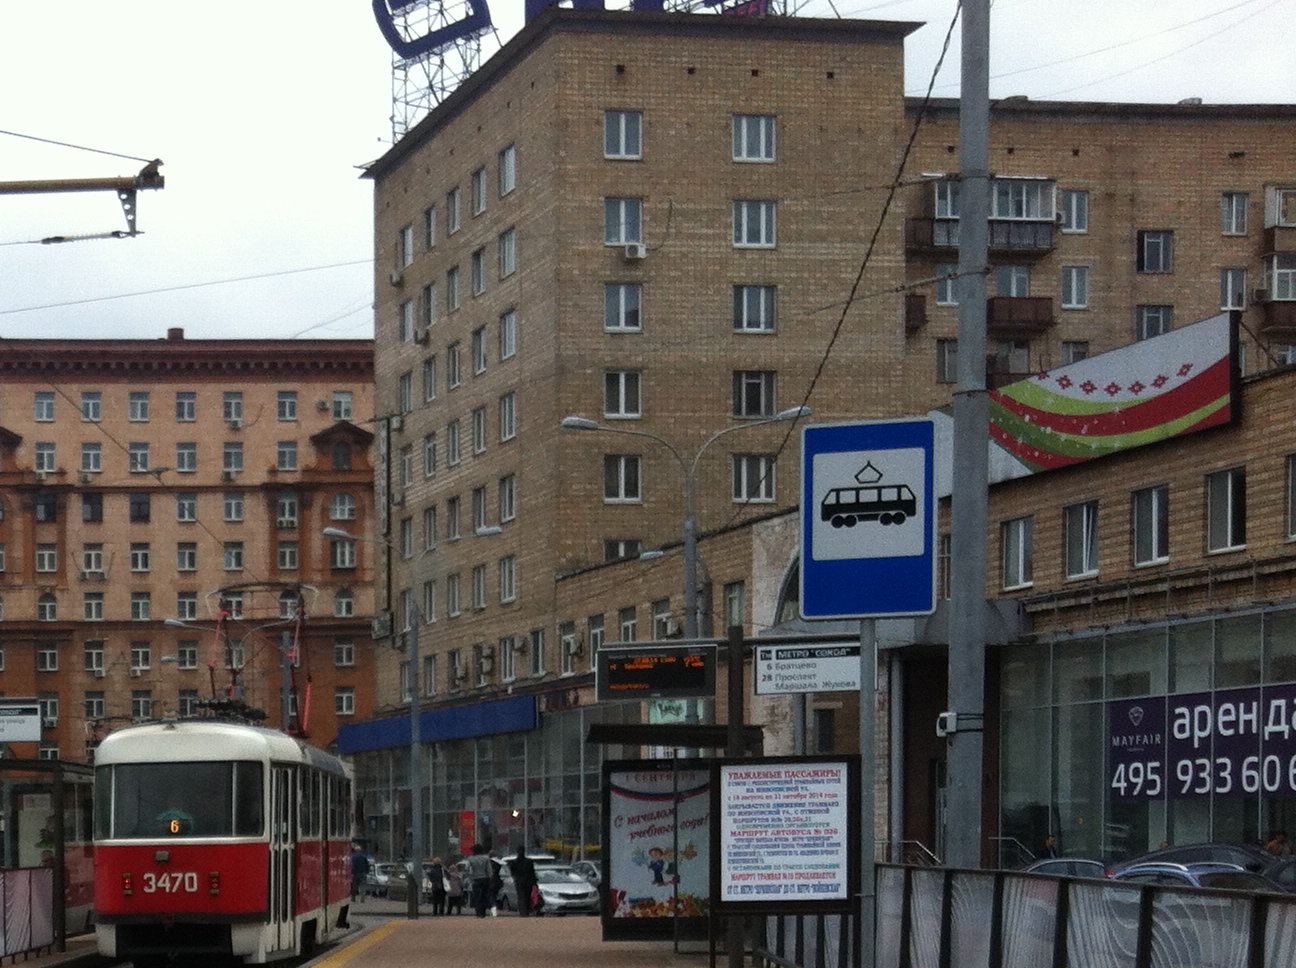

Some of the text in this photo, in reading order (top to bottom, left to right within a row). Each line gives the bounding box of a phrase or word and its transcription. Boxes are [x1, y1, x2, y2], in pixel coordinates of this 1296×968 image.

[778, 651, 809, 659] МЕТРО
[810, 648, 851, 657] "СОКОЛ"
[766, 662, 817, 672] 6 Братцево
[775, 673, 817, 682] Проспект
[775, 681, 856, 690] Маршала Жукова
[1173, 699, 1296, 749] аренд
[1112, 733, 1161, 747] MAYFAIR
[728, 769, 841, 780] УВАЖАЕМЫЕ ПАССАЖИРЫ!
[1111, 761, 1161, 796] 495
[1176, 757, 1232, 794] 933
[1241, 755, 1281, 793] 60
[170, 820, 179, 833] 6
[143, 872, 198, 893] 3470
